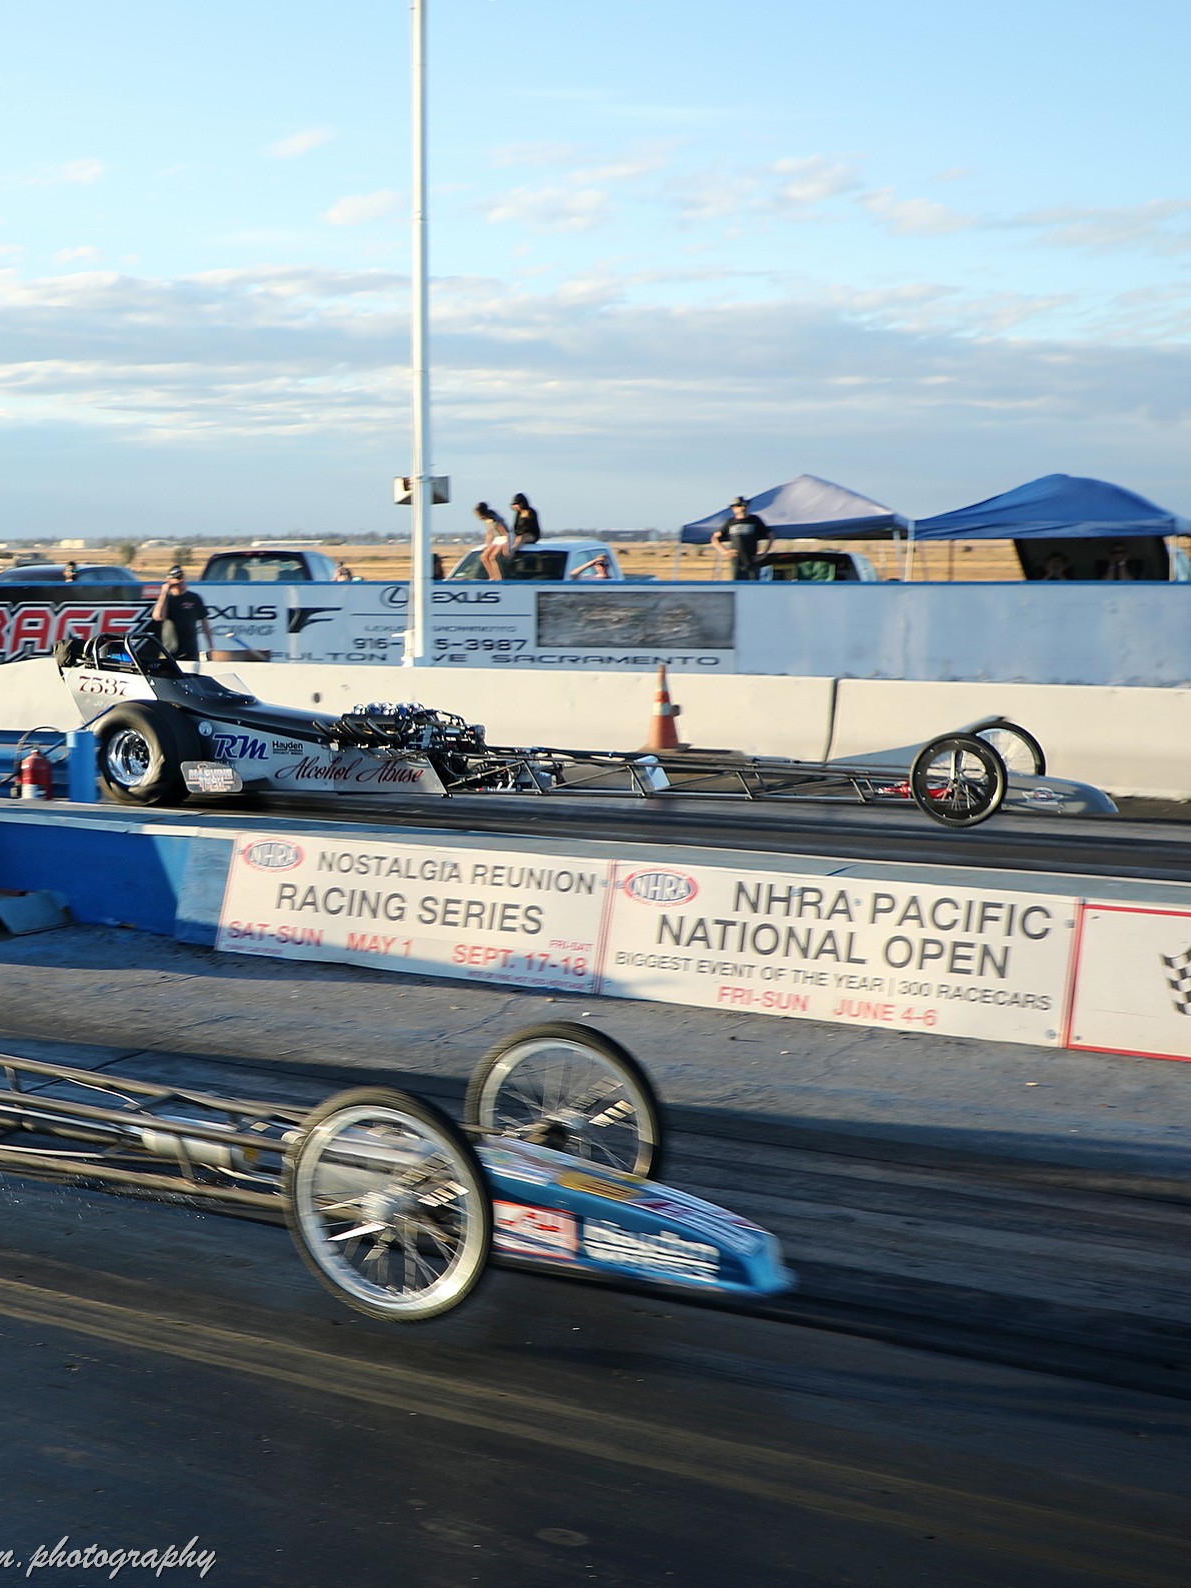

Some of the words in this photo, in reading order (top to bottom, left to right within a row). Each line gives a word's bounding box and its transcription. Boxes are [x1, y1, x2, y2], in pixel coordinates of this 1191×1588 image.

[432, 591, 501, 604] EXUS
[491, 654, 721, 667] SACRAMENTO
[79, 676, 129, 697] 7537
[213, 733, 269, 760] RM
[272, 741, 304, 751] Hayden
[275, 756, 363, 781] Alcohol
[356, 758, 424, 783] Abuse
[316, 850, 462, 884] NOSTALGIA
[470, 863, 597, 896] REUNION
[276, 883, 407, 922] RACING
[417, 895, 546, 935] SERIES
[732, 880, 855, 924] NHRA
[868, 891, 1053, 941] PACIFIC
[228, 920, 324, 947] SAT-SUN
[346, 931, 396, 953] MAY
[403, 938, 415, 957] 1
[452, 943, 515, 969] SEPT.
[525, 951, 589, 977] 17-18
[655, 913, 867, 966] NATIONAL
[883, 933, 1011, 979] OPEN
[614, 951, 691, 972] BIGGEST
[696, 959, 756, 979] EVENT
[761, 966, 788, 981] OF
[791, 969, 829, 987] THE
[833, 973, 884, 993] YEAR
[898, 980, 932, 998] 300
[937, 984, 1053, 1011] RACECARS
[717, 985, 810, 1013] FRI-SUN
[833, 999, 896, 1022] JUNE
[901, 1007, 939, 1027] 4-6
